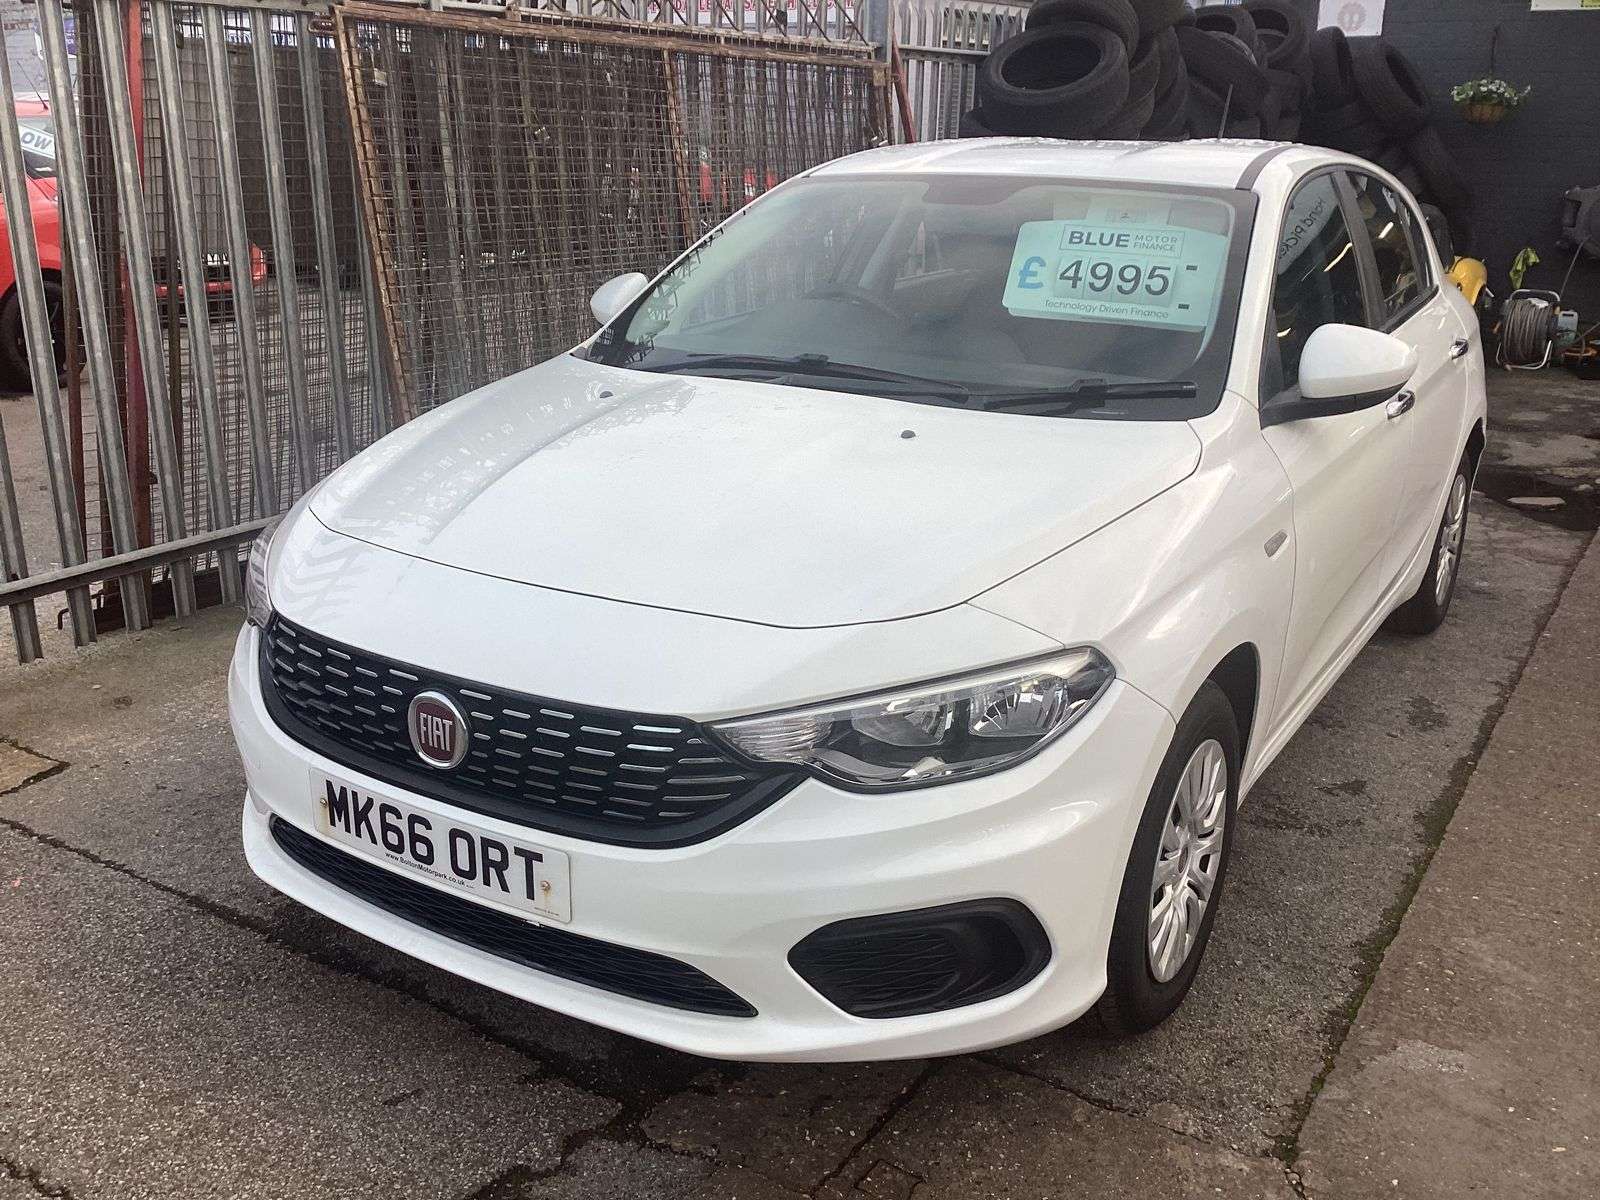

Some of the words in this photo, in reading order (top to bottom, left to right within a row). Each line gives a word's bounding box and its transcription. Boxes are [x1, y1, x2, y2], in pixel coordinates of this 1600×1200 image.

[1068, 230, 1131, 248] BLUE
[1133, 241, 1176, 252] FINANCE
[1134, 234, 1178, 244] MOTOR
[1045, 299, 1098, 313] Technology
[1099, 304, 1128, 314] Driven
[1130, 307, 1169, 319] Finance
[419, 712, 453, 752] FIAT
[325, 779, 435, 866] MK66
[448, 827, 544, 901] ORT
